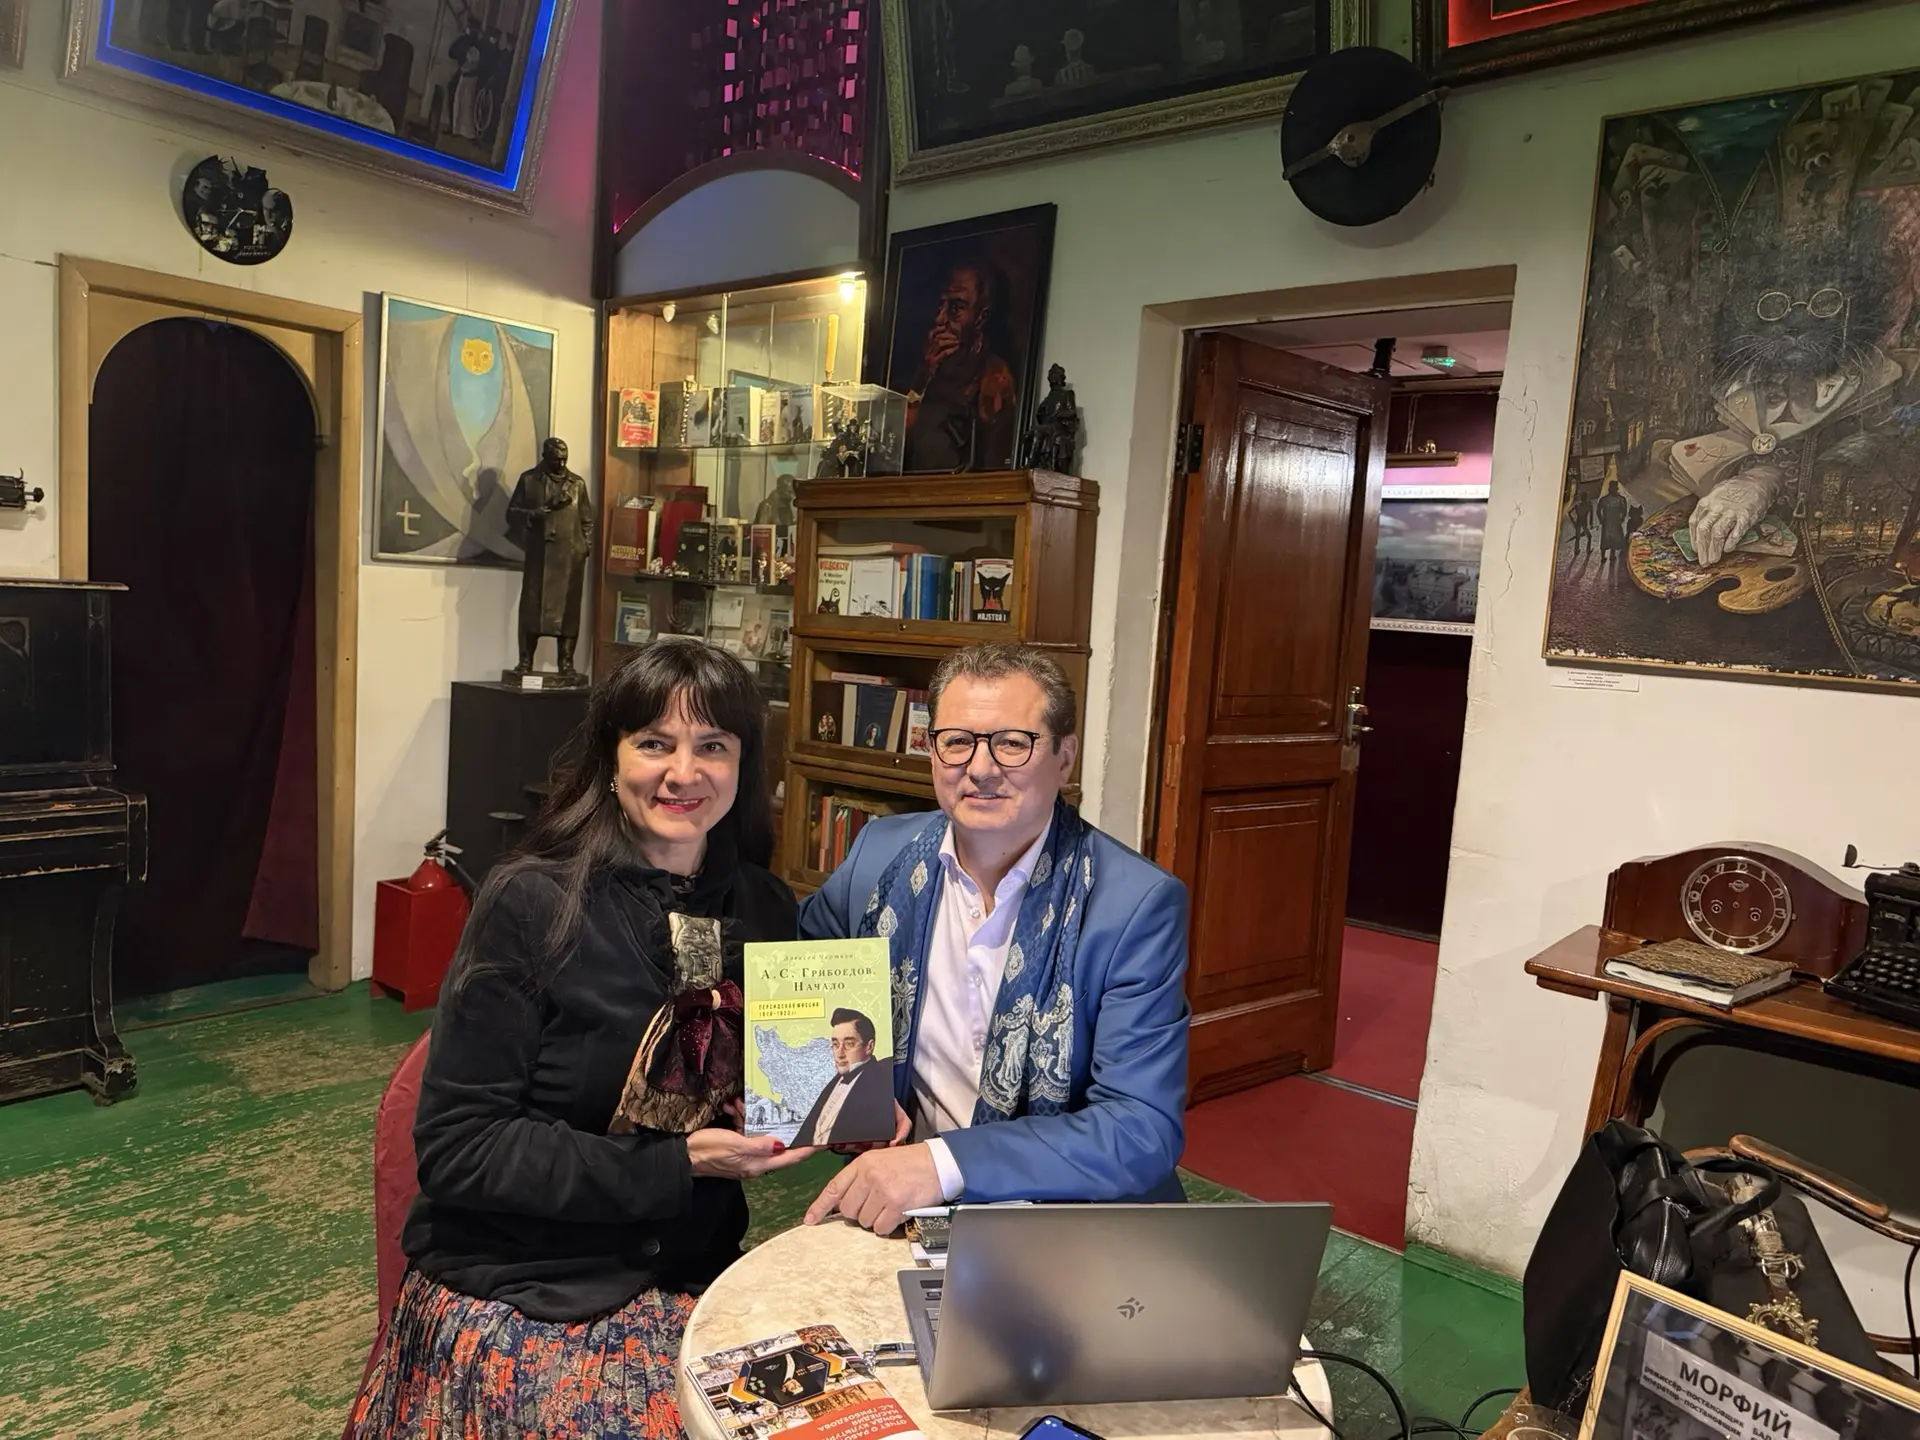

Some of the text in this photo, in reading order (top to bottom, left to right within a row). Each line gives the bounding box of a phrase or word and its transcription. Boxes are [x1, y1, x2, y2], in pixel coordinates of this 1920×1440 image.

[1679, 1361, 1792, 1440] МОРФИЙ
[817, 1408, 878, 1432] ГРИБОЕДОВА
[851, 1409, 900, 1426] НАСЛЕДИЯ
[871, 1414, 904, 1426] ФОНДА
[880, 1419, 908, 1429] ОТЧЕТ
[840, 1429, 870, 1440] РАБО
